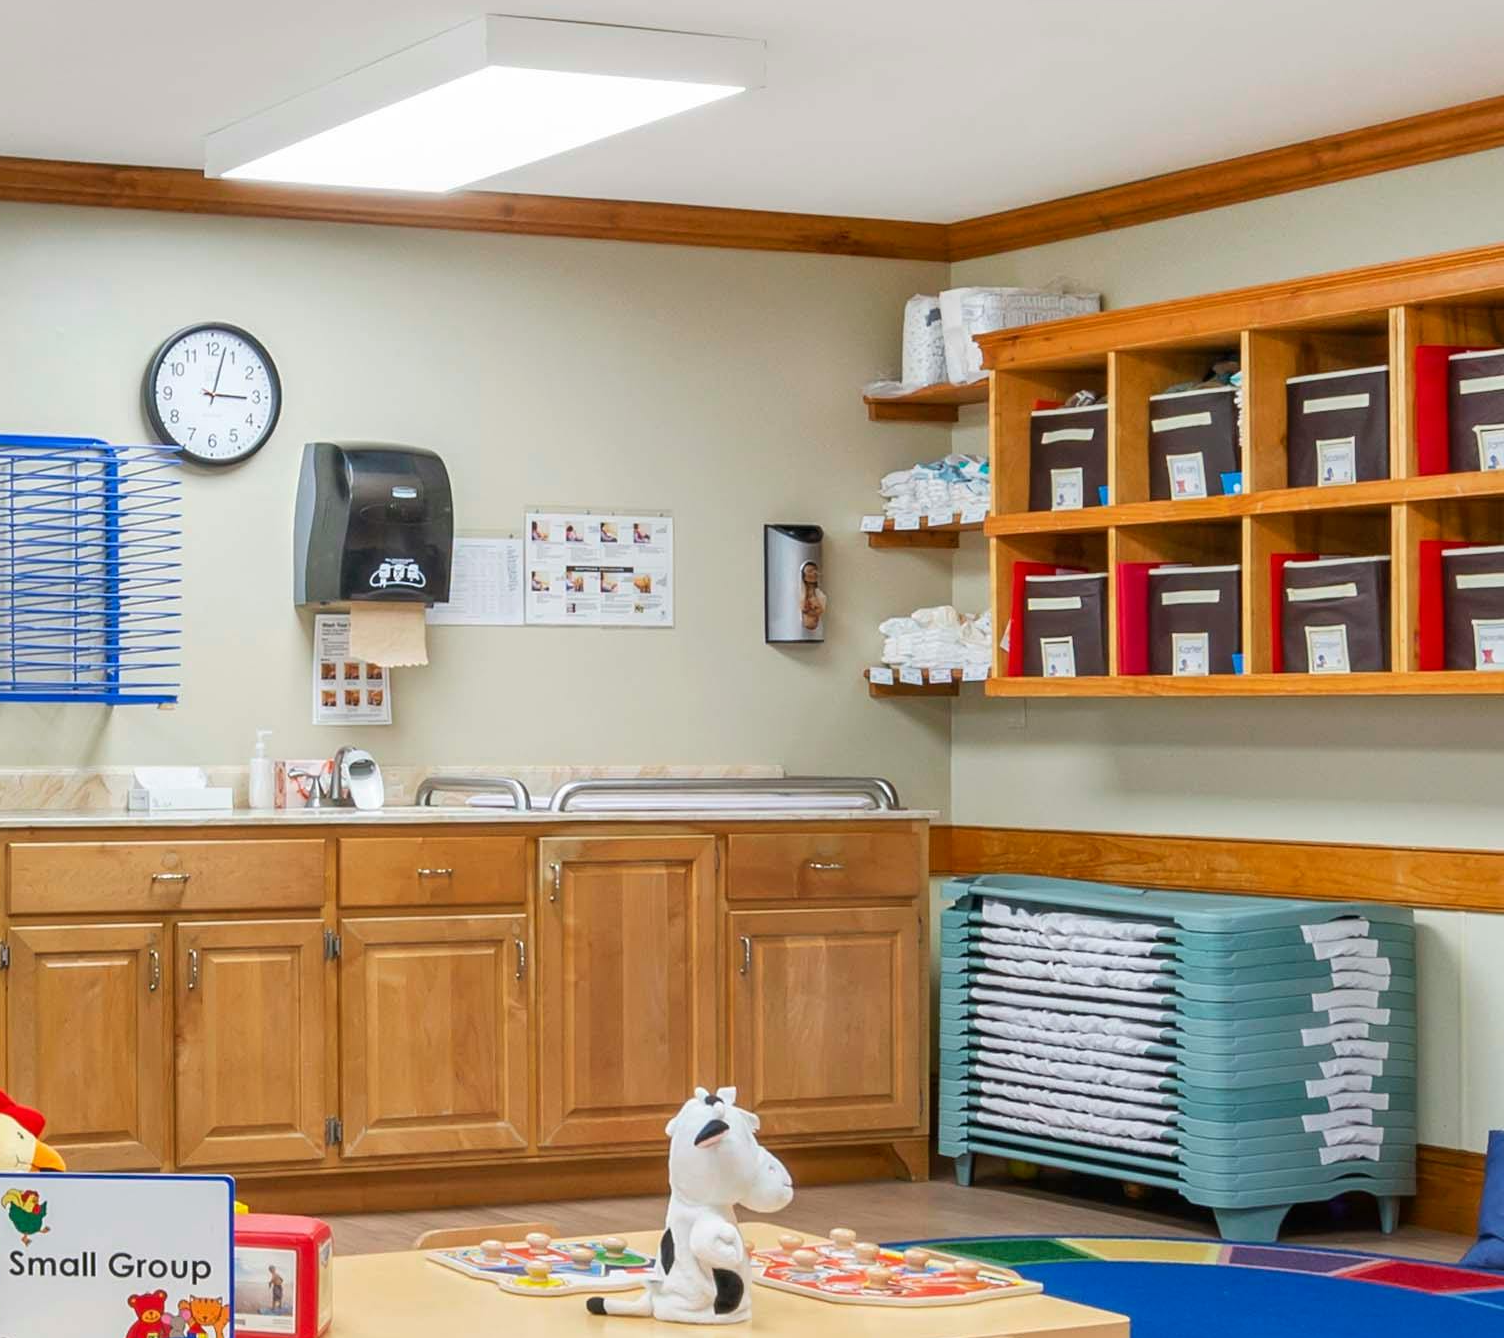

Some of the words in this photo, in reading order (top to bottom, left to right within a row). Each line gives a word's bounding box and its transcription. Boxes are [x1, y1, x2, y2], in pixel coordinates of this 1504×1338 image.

[185, 349, 197, 363] 11
[206, 342, 220, 356] 12
[230, 351, 235, 365] 1
[171, 362, 185, 377] 10
[245, 366, 254, 380] 2
[163, 386, 173, 401] 9
[252, 390, 261, 404] 3
[170, 409, 180, 424] 8
[245, 413, 254, 426] 4
[187, 427, 197, 441] 7
[208, 433, 217, 448] 6
[229, 429, 238, 443] 5
[9, 1251, 96, 1277] Small
[108, 1252, 212, 1286] Group
